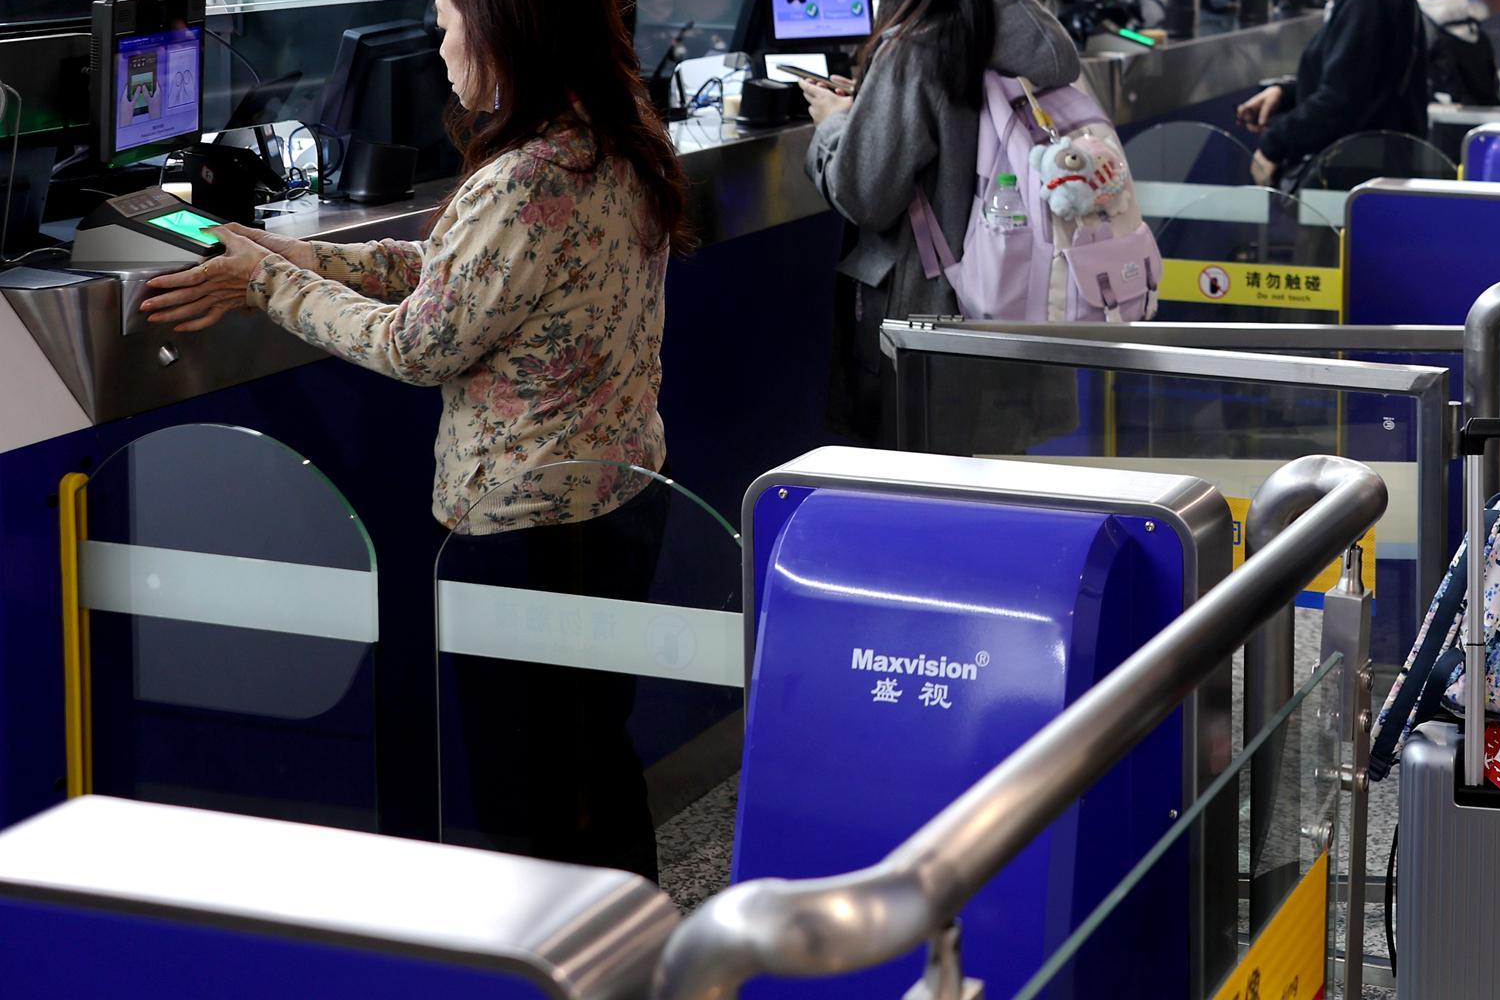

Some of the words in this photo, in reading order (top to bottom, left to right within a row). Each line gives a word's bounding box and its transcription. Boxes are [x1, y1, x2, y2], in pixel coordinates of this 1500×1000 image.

[1245, 271, 1321, 292] 请勿触碰
[1257, 292, 1269, 300] Do
[1271, 293, 1285, 301] not
[1287, 294, 1311, 302] touch
